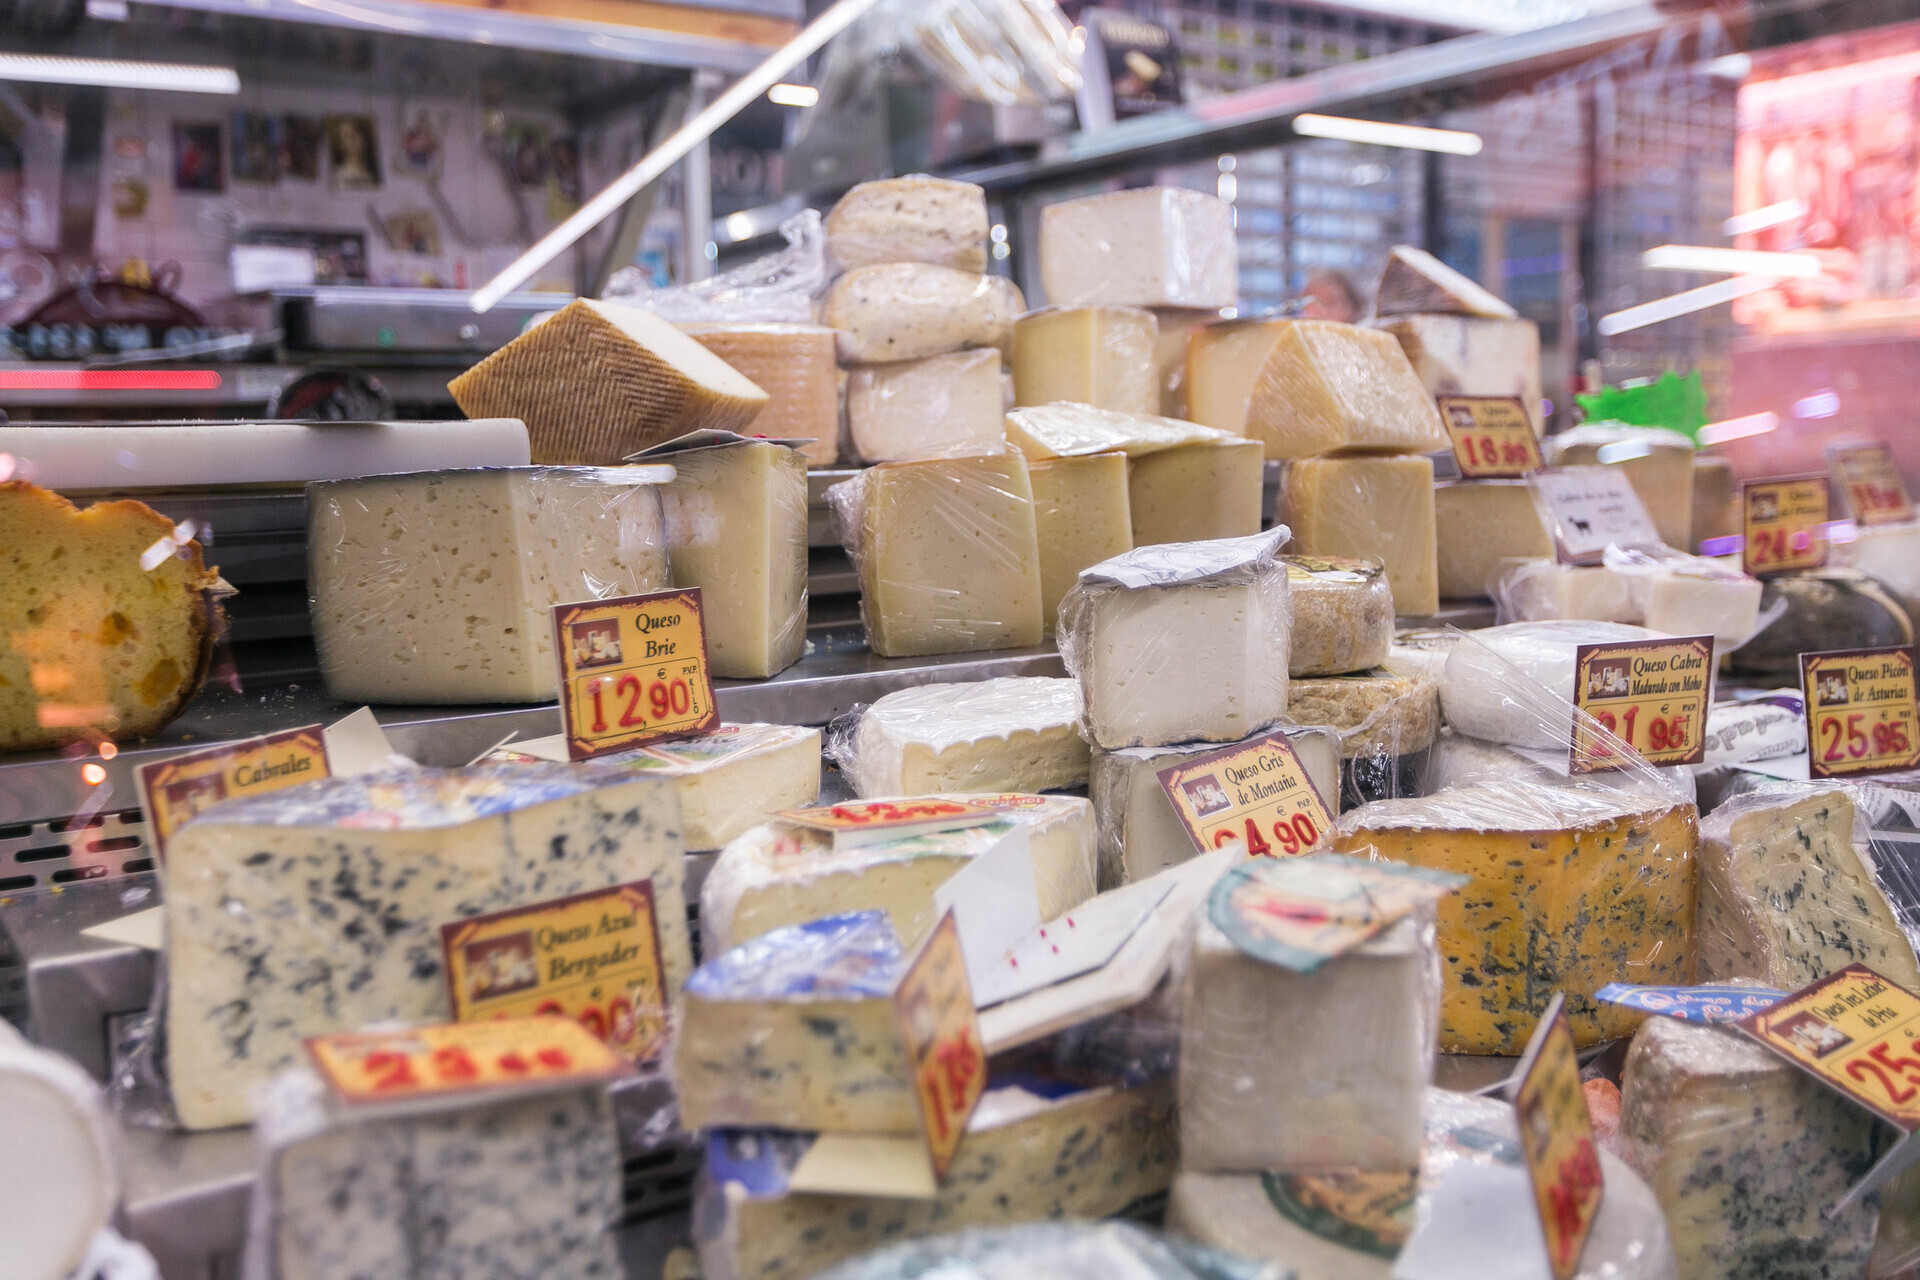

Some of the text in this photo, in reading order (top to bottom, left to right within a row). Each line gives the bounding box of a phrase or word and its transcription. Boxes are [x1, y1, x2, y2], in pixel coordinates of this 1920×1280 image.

[635, 613, 681, 634] Queso
[644, 638, 677, 658] Brie
[1633, 653, 1703, 676] Queso Cabra
[1848, 663, 1909, 684] Queso Picón
[1631, 675, 1703, 696] Madurado con Moho
[1853, 684, 1909, 703] de Asturias
[234, 753, 312, 788] Cabrales
[1224, 752, 1285, 786] Queso Gris
[1238, 774, 1298, 807] de Montaña
[536, 908, 638, 951] Queso Azul
[549, 942, 641, 981] Bergader
[1812, 980, 1888, 1022] Queso Tres Leches
[1857, 1013, 1880, 1029] de
